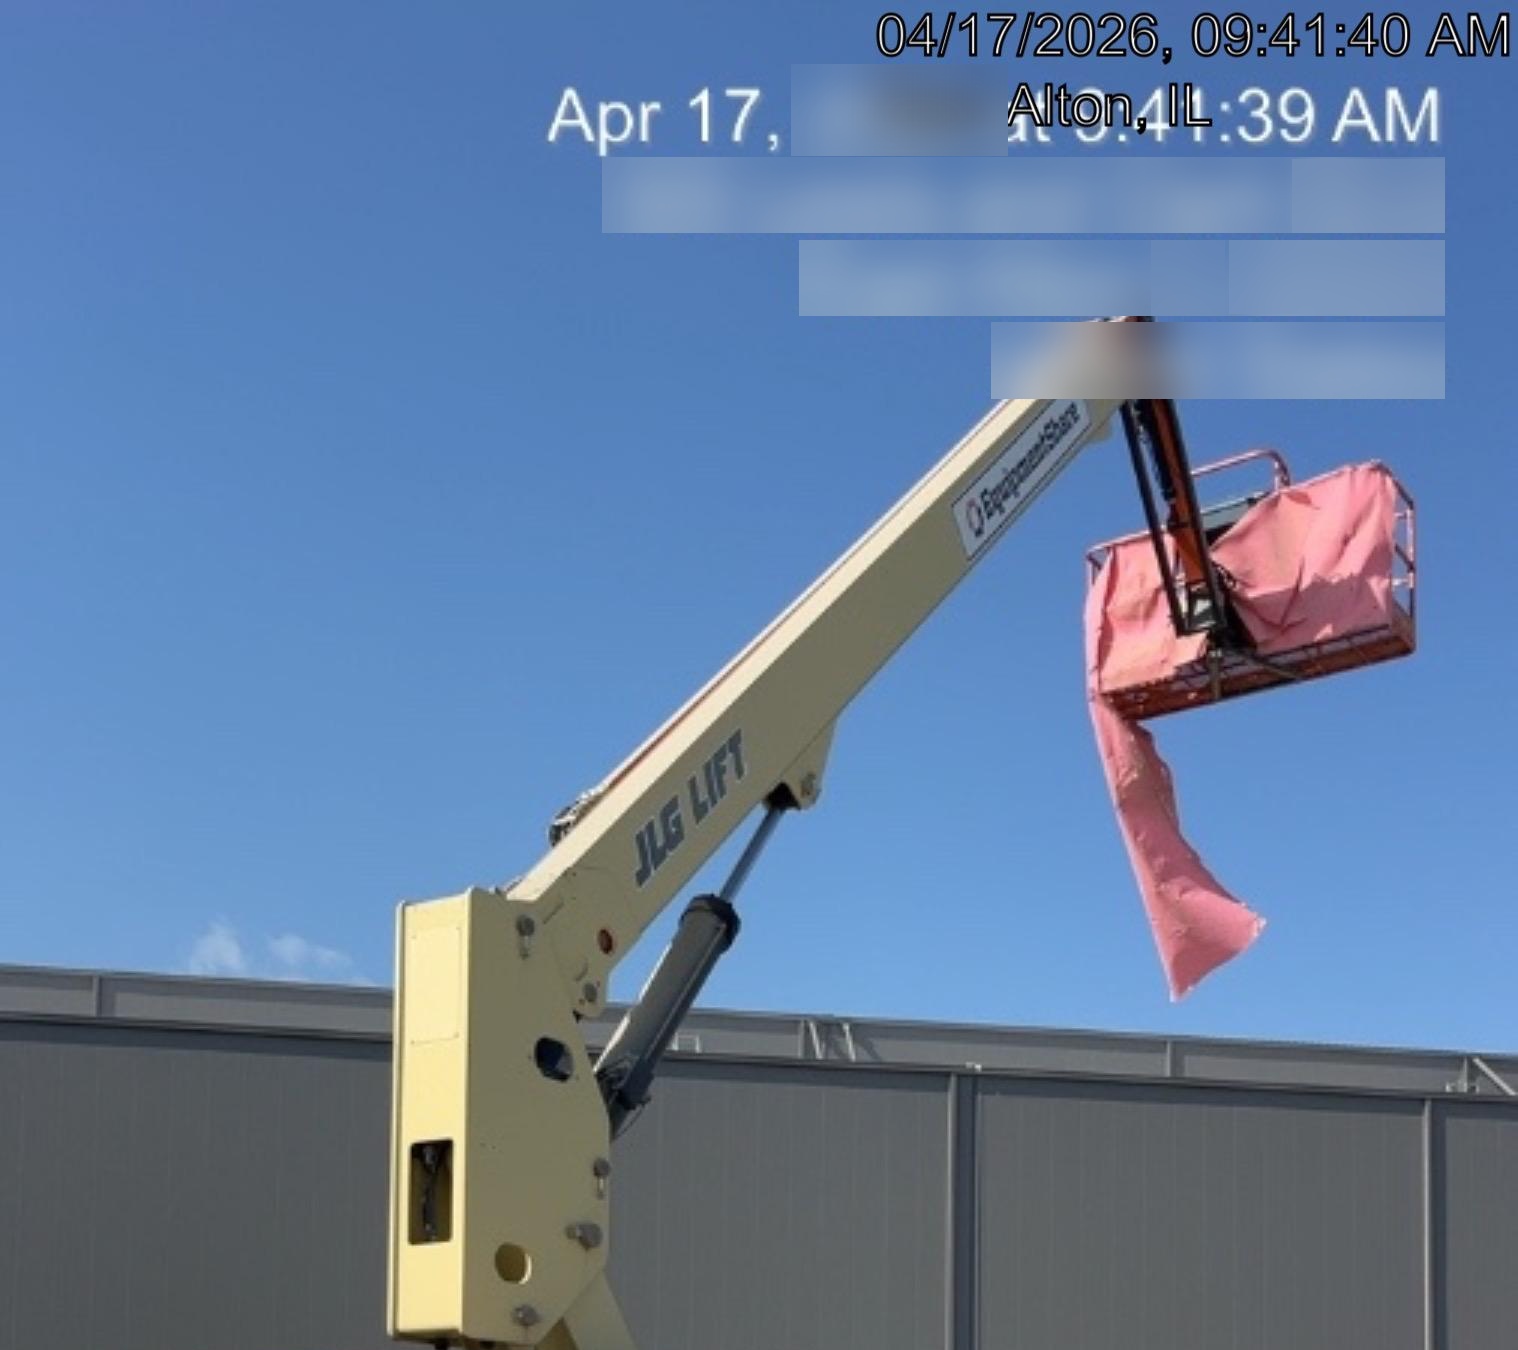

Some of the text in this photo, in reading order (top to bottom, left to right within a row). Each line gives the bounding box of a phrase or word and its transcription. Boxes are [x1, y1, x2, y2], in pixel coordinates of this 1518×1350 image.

[979, 403, 1081, 520] EquipmentShare
[635, 727, 745, 887] JLG LIFT
